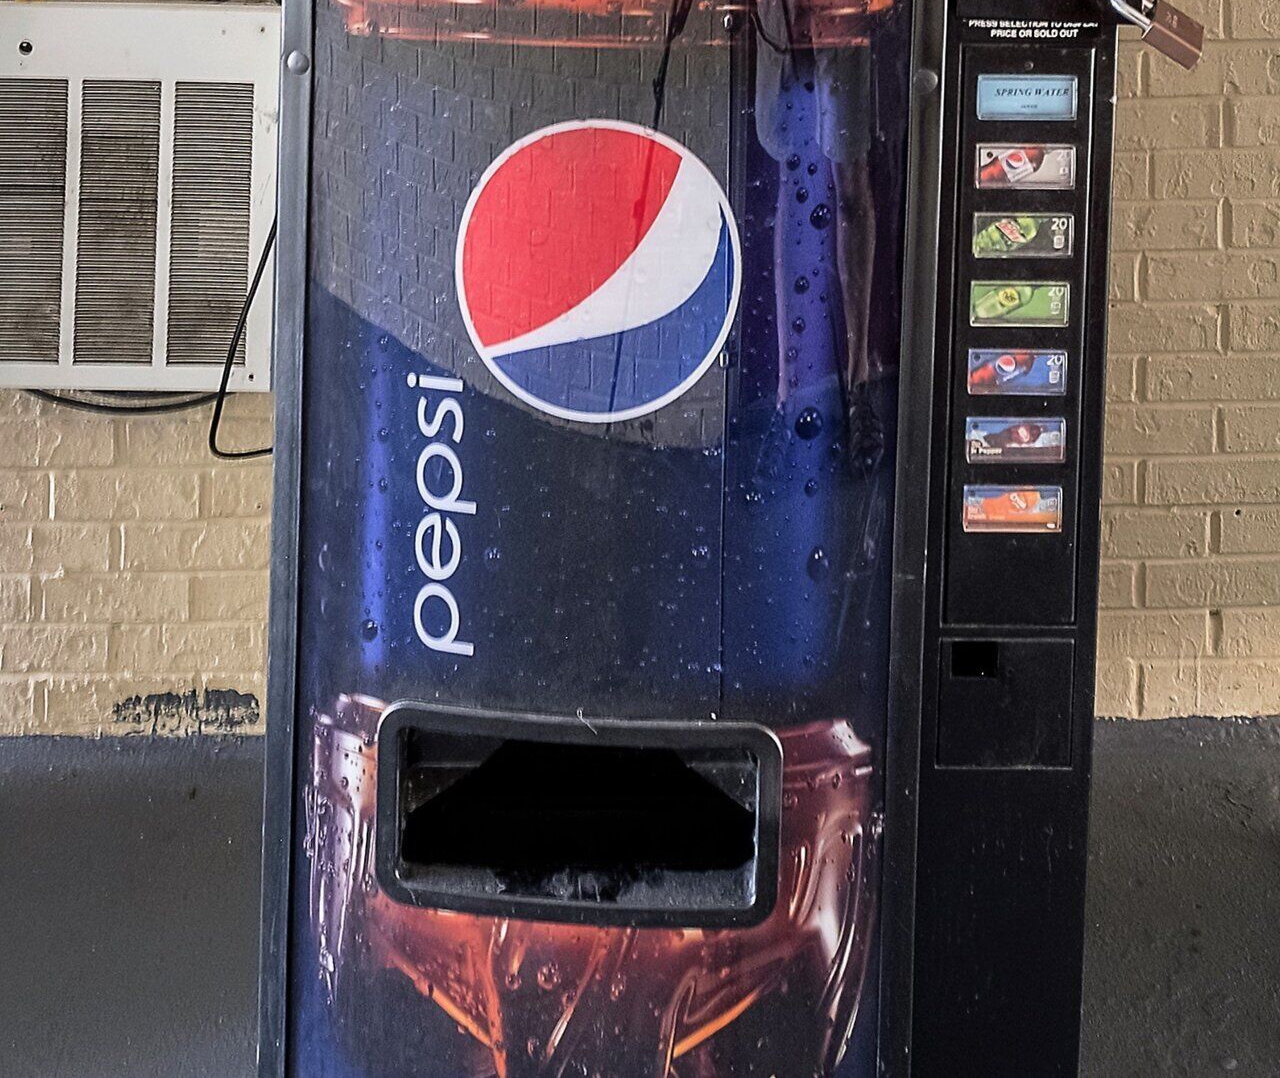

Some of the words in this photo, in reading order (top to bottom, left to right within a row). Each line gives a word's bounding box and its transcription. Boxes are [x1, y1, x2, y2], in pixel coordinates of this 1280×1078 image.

[968, 19, 998, 27] PRESS
[999, 20, 1049, 28] SELECTION
[990, 29, 1017, 38] PRICE
[1018, 29, 1032, 38] OR
[1034, 29, 1058, 38] SOLD
[1059, 29, 1079, 38] OUT
[994, 88, 1032, 97] SPRING
[1034, 88, 1070, 97] WATER
[1051, 217, 1068, 230] 20
[1048, 286, 1064, 297] 20
[1046, 354, 1063, 366] 20
[407, 372, 477, 656] pepsi
